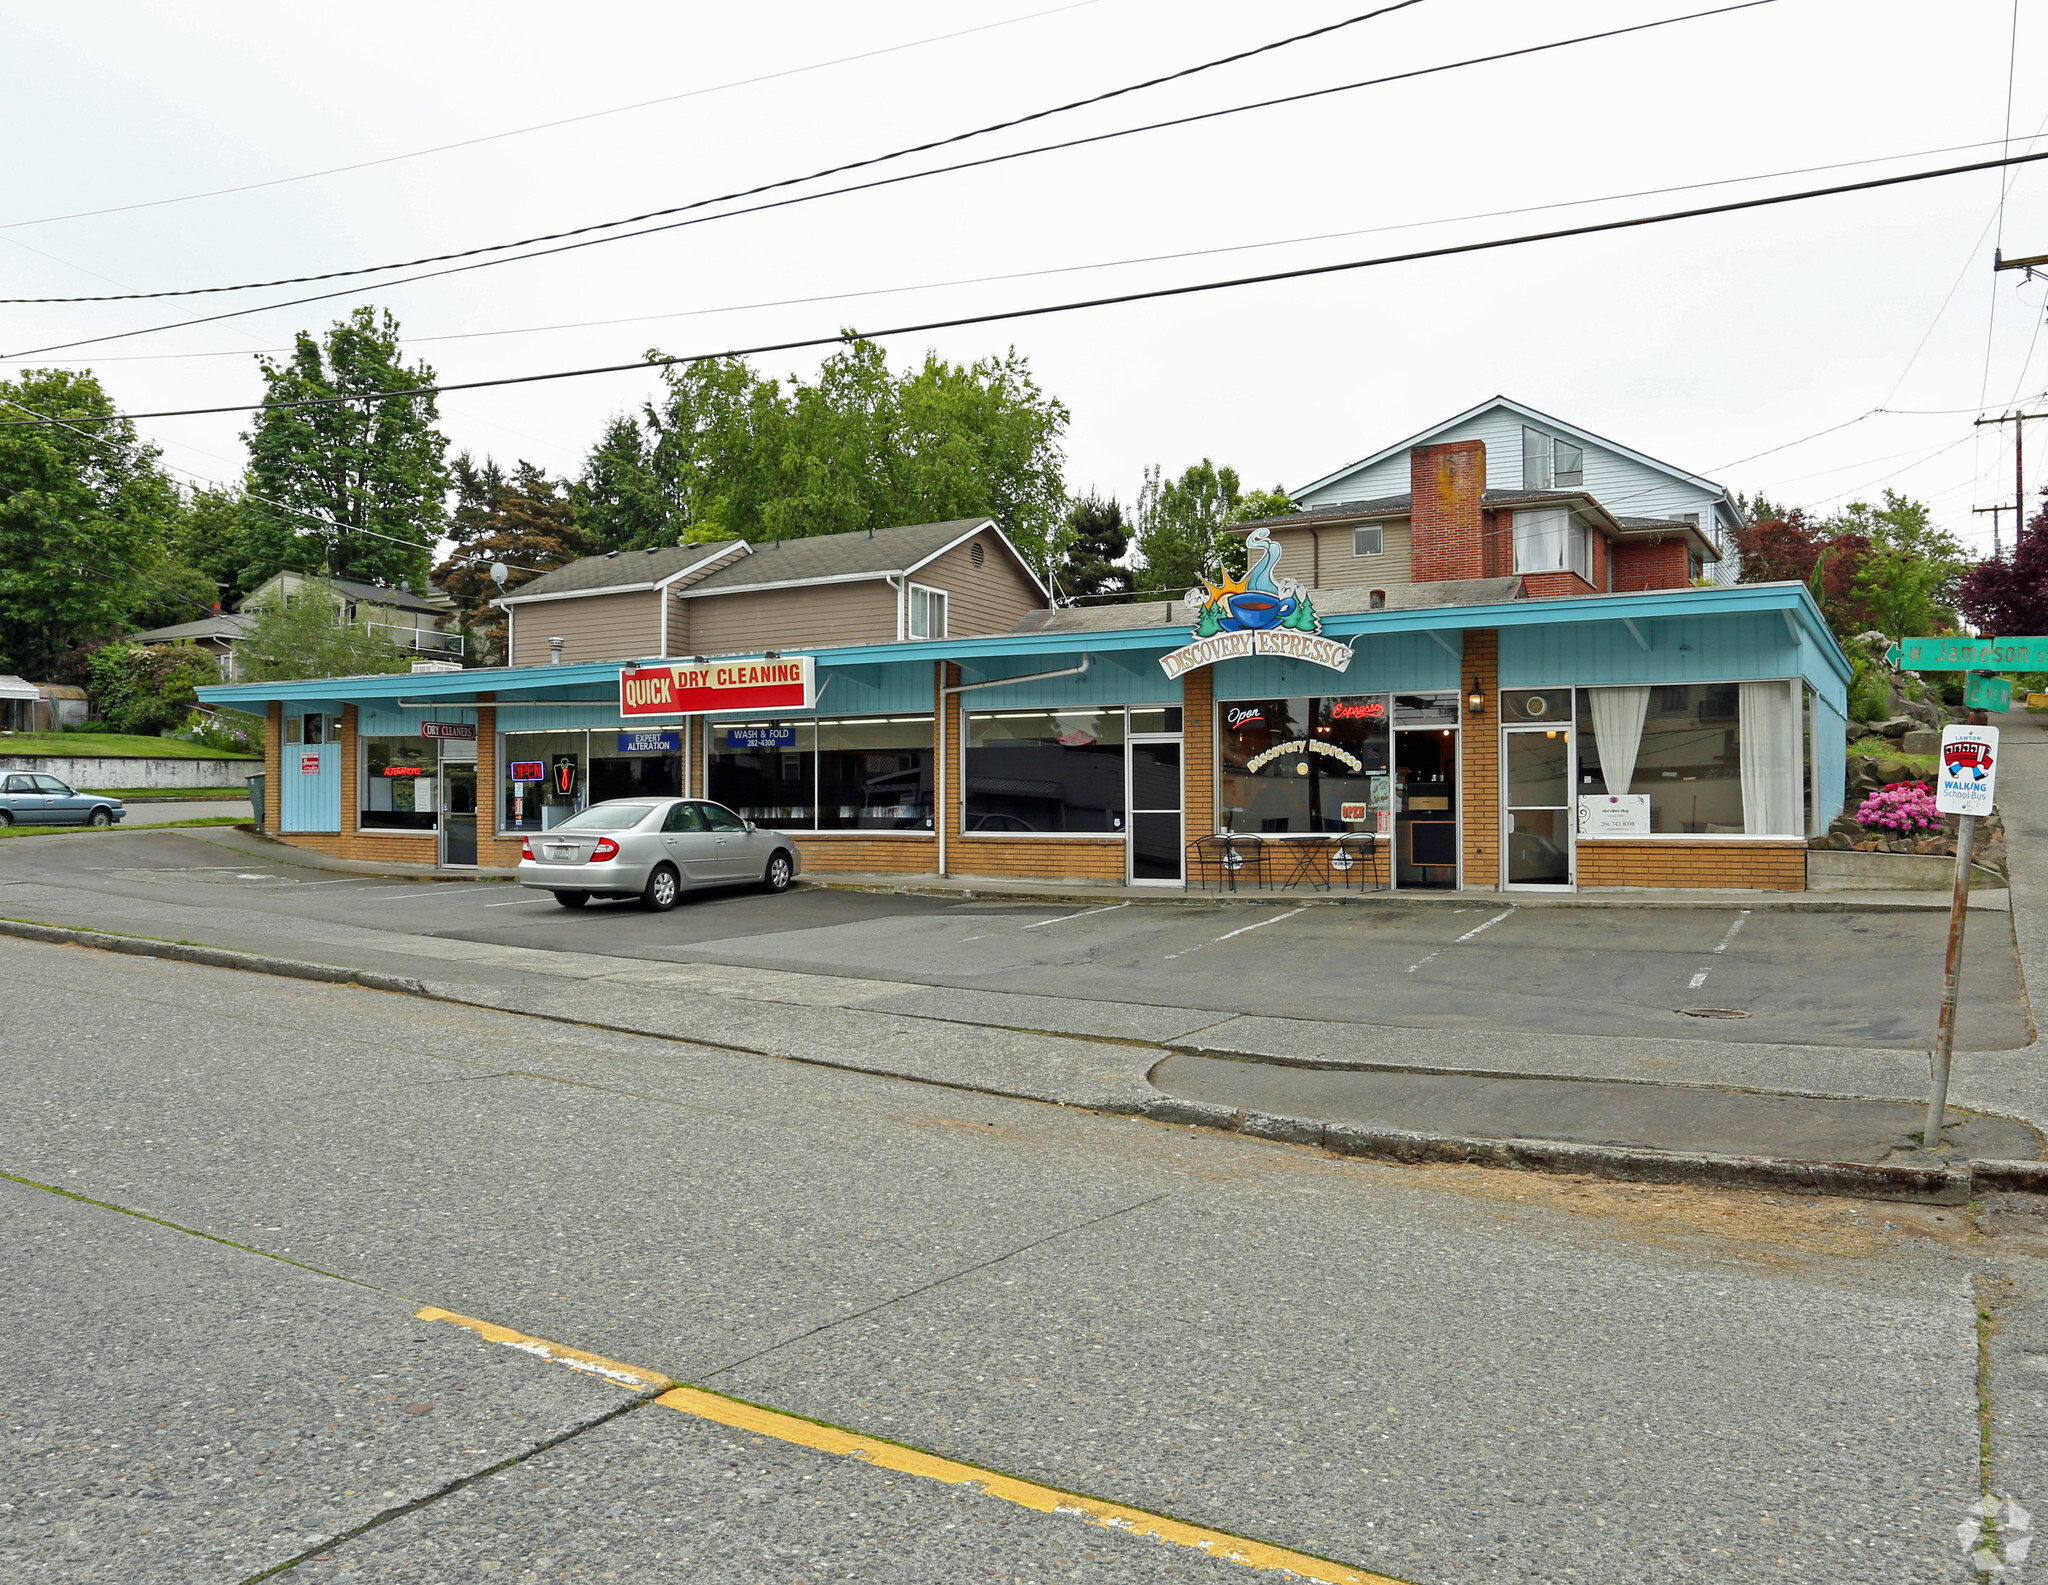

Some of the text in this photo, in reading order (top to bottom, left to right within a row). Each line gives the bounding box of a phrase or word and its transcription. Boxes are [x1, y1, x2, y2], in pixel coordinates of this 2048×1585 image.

[1162, 633, 1251, 676] DISCOVERY
[1910, 641, 2048, 662] W Jameson S
[625, 664, 800, 708] QUICK DRY CLEANING
[1228, 707, 1260, 724] Open
[1332, 703, 1384, 718] Espresso
[427, 725, 472, 737] DRY CLEANERS
[734, 729, 789, 739] WASH & FOLD
[635, 734, 662, 743] EXPERT
[747, 739, 776, 747] 282-4300
[627, 741, 670, 750] ALTERATION
[1247, 739, 1363, 773] Discovery Espresso
[384, 766, 422, 776] ALTERATIONS
[513, 763, 542, 779] OPEN
[1944, 781, 1987, 792] WALKING
[1943, 789, 1986, 800] School Bus
[1343, 806, 1365, 818] OPEN
